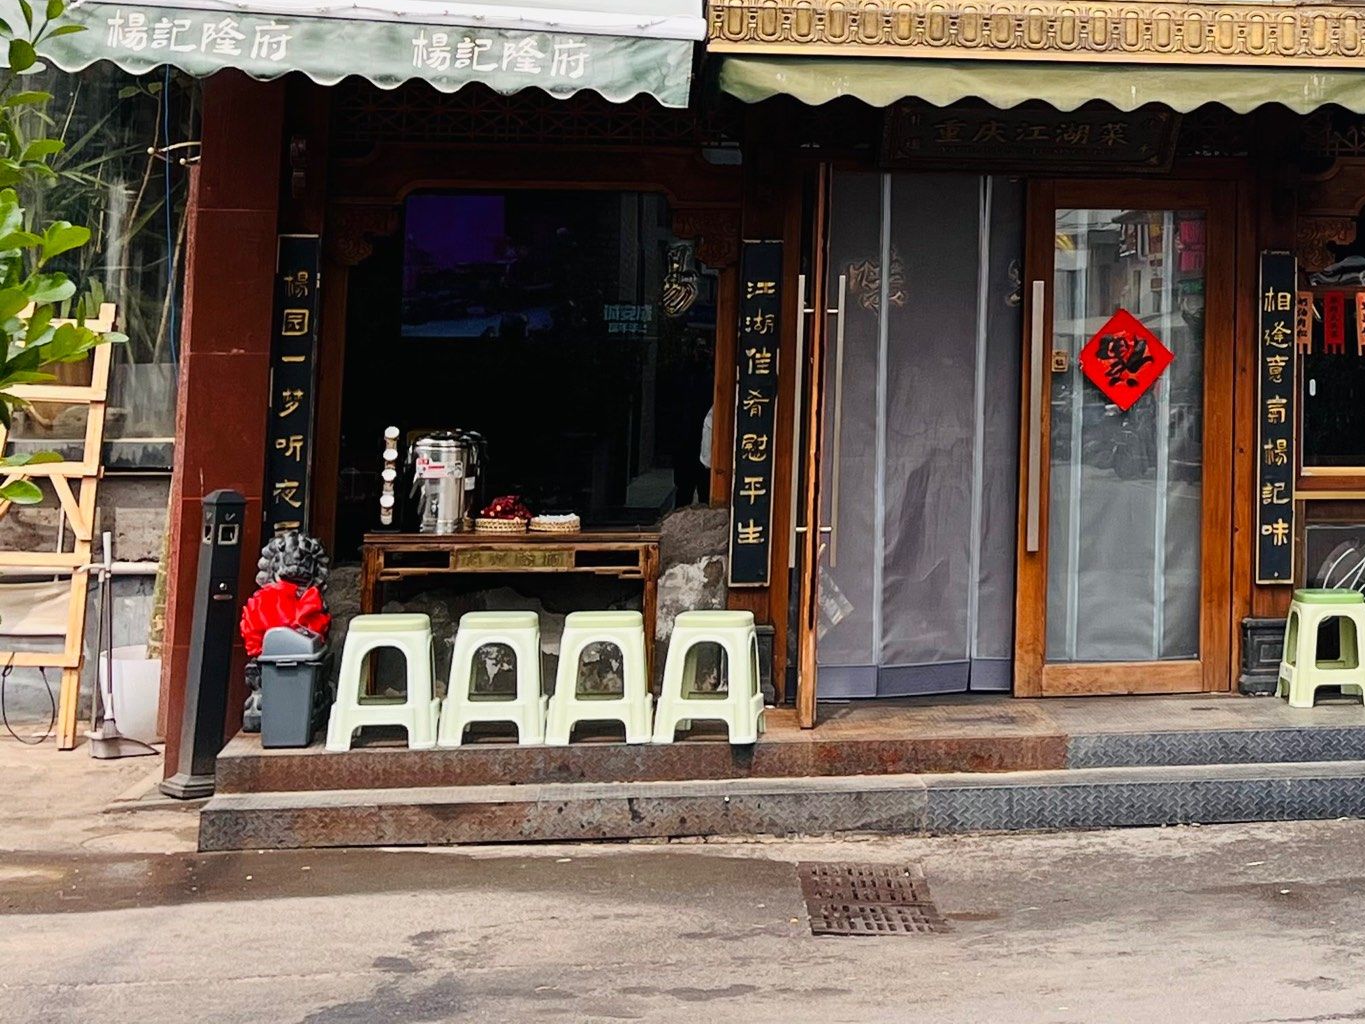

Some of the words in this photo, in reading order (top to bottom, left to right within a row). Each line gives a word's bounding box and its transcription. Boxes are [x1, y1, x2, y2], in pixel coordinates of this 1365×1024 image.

[107, 10, 293, 63] 楊記隆府
[412, 30, 590, 79] 楊記隆府
[272, 270, 310, 534] 楊园一梦听夜
[737, 279, 776, 546] 江湖佳肴慰平生
